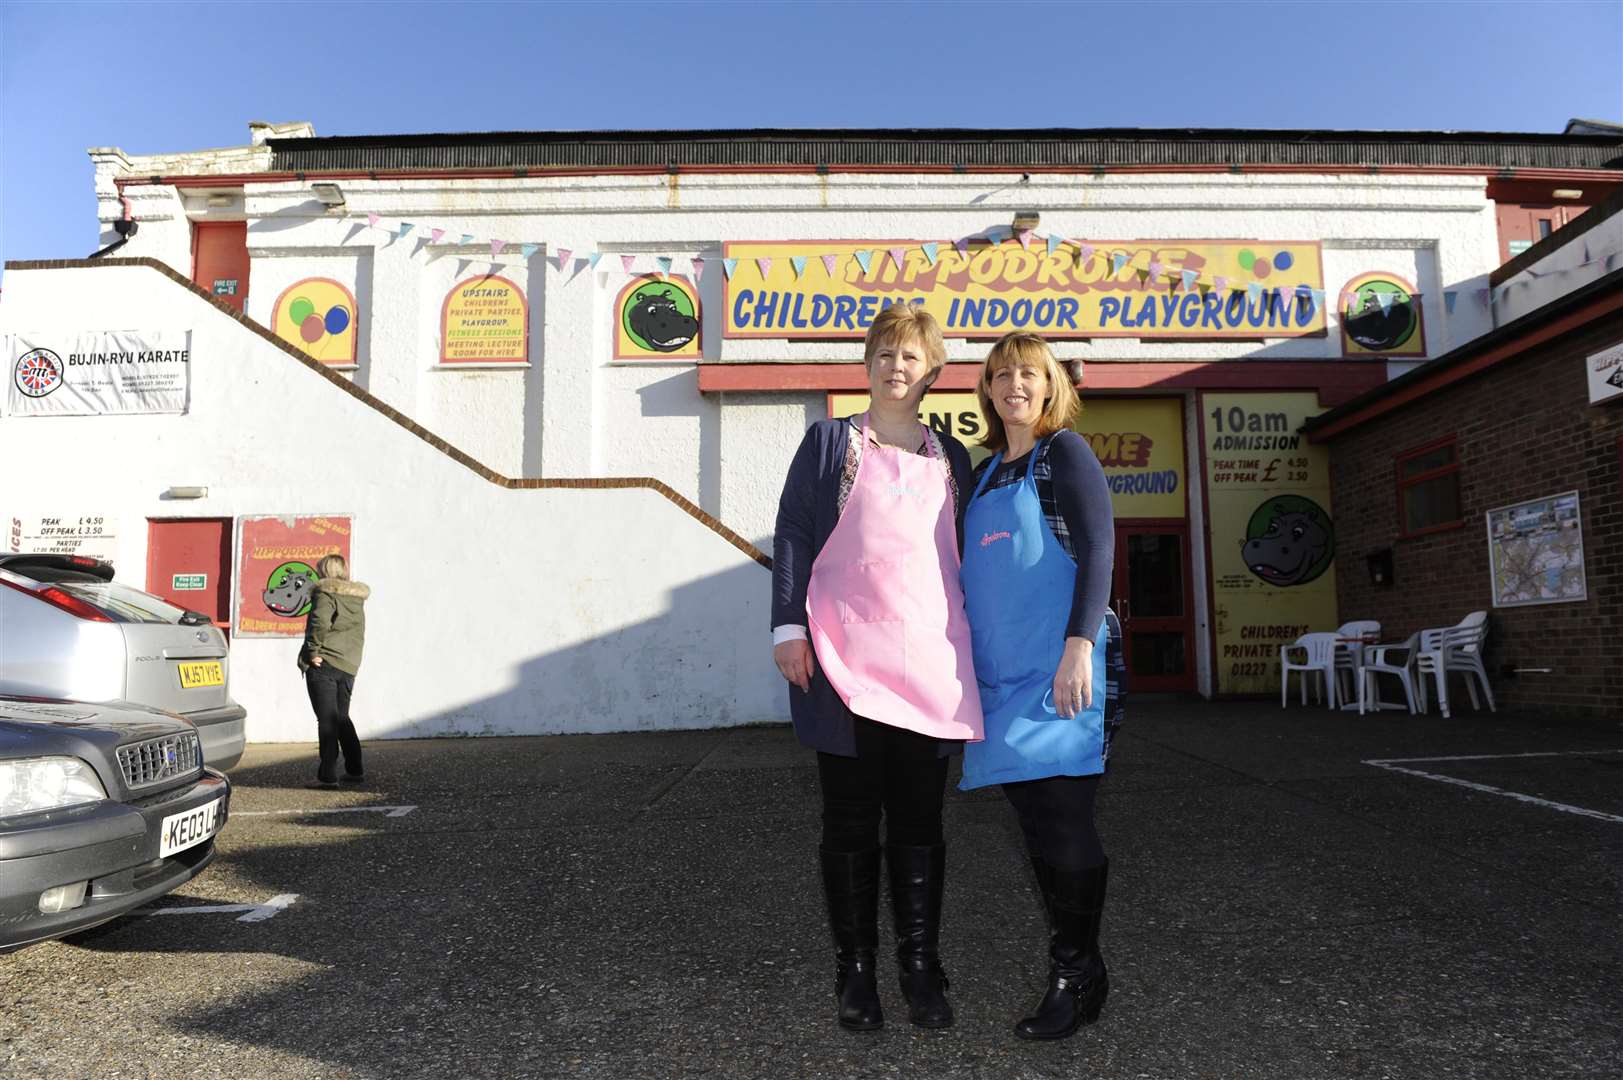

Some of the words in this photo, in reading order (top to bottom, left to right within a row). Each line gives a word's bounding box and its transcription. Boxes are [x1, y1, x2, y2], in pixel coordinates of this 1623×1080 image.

[845, 245, 1201, 292] HIPPODROME
[462, 288, 510, 298] UPSTAIRS
[464, 299, 509, 307] CHILDRENS
[733, 290, 925, 330] CHILDRE
[946, 297, 1080, 329] INDOOR
[1098, 285, 1316, 331] PLAYGROUND
[448, 329, 480, 337] FITNESS
[484, 328, 522, 336] SESSIONS
[488, 340, 523, 348] LECTURE
[69, 352, 133, 366] BUJIN-RYU
[138, 350, 189, 364] KARATE
[918, 412, 980, 436] NS
[1212, 406, 1288, 432] 10am
[1213, 436, 1300, 450] ADMISSION
[1214, 460, 1235, 469] PEAK
[1238, 460, 1260, 469] TIME
[1260, 458, 1282, 482] £
[1214, 473, 1232, 482] OFF
[1234, 473, 1257, 482] PEAK
[42, 518, 61, 526] PEAK
[40, 527, 55, 535] OFF
[56, 527, 75, 535] PEAK
[1241, 625, 1309, 639] CHILDREN'S
[1224, 644, 1273, 658] PRIVATE
[183, 666, 205, 684] MJ57
[1232, 662, 1266, 676] 01227
[169, 810, 204, 849] KE03
